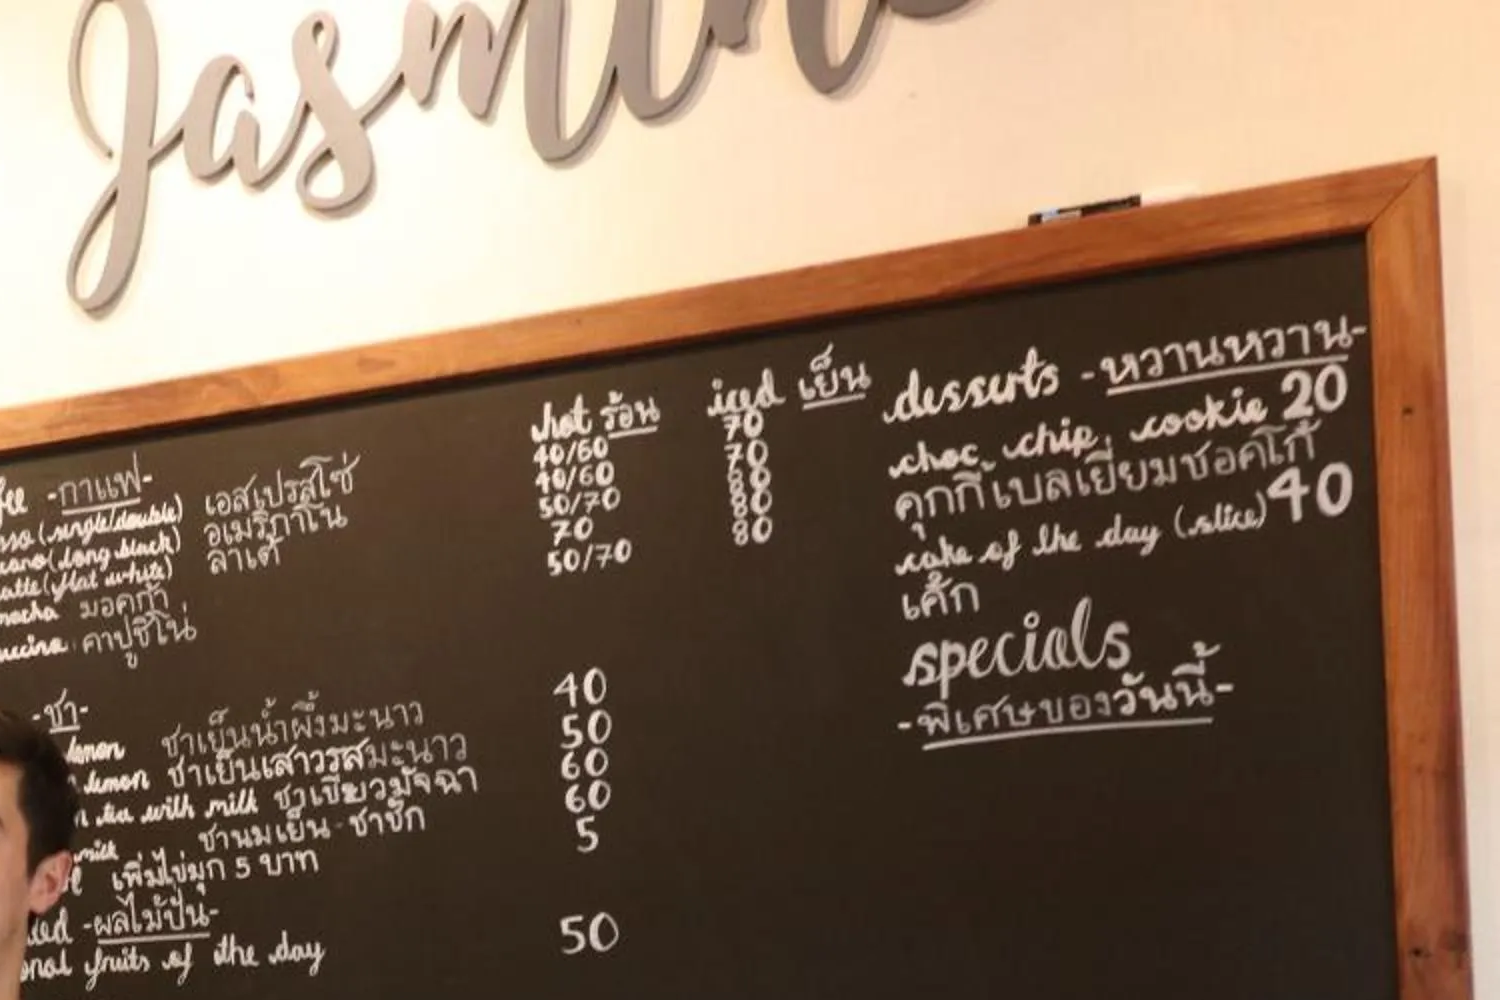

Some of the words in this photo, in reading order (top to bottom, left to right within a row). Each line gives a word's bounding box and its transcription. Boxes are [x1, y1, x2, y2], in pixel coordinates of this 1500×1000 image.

[799, 342, 873, 401] เย็น
[882, 345, 1060, 425] desserts
[600, 390, 661, 430] ร้อน
[706, 367, 787, 417] iced
[1002, 416, 1100, 460] chip
[1129, 386, 1268, 443] cookie
[1280, 363, 1348, 421] 20
[531, 393, 593, 443] hot
[722, 408, 764, 442] 70
[533, 435, 609, 469] 40/60
[724, 438, 769, 470] 70
[534, 459, 615, 494] 40/60
[538, 485, 622, 520] 50/70
[895, 535, 973, 576] cake
[979, 528, 1022, 571] of
[1032, 522, 1082, 557] the
[1095, 512, 1162, 556] day
[1174, 490, 1267, 539] (slice)
[1266, 461, 1353, 523] 40
[550, 515, 594, 547] 70
[731, 515, 773, 546] 80
[547, 537, 633, 577] 50/70
[903, 596, 1131, 700] specials
[552, 665, 607, 709] 40
[560, 708, 613, 749] 50
[560, 747, 609, 780] 60
[140, 793, 195, 824] with
[204, 787, 259, 819] milk
[564, 779, 612, 814] 60
[575, 815, 600, 853] 5
[235, 857, 251, 880] 5
[559, 911, 620, 955] 50
[161, 943, 194, 986] of
[212, 932, 260, 968] the
[267, 930, 326, 977] day
